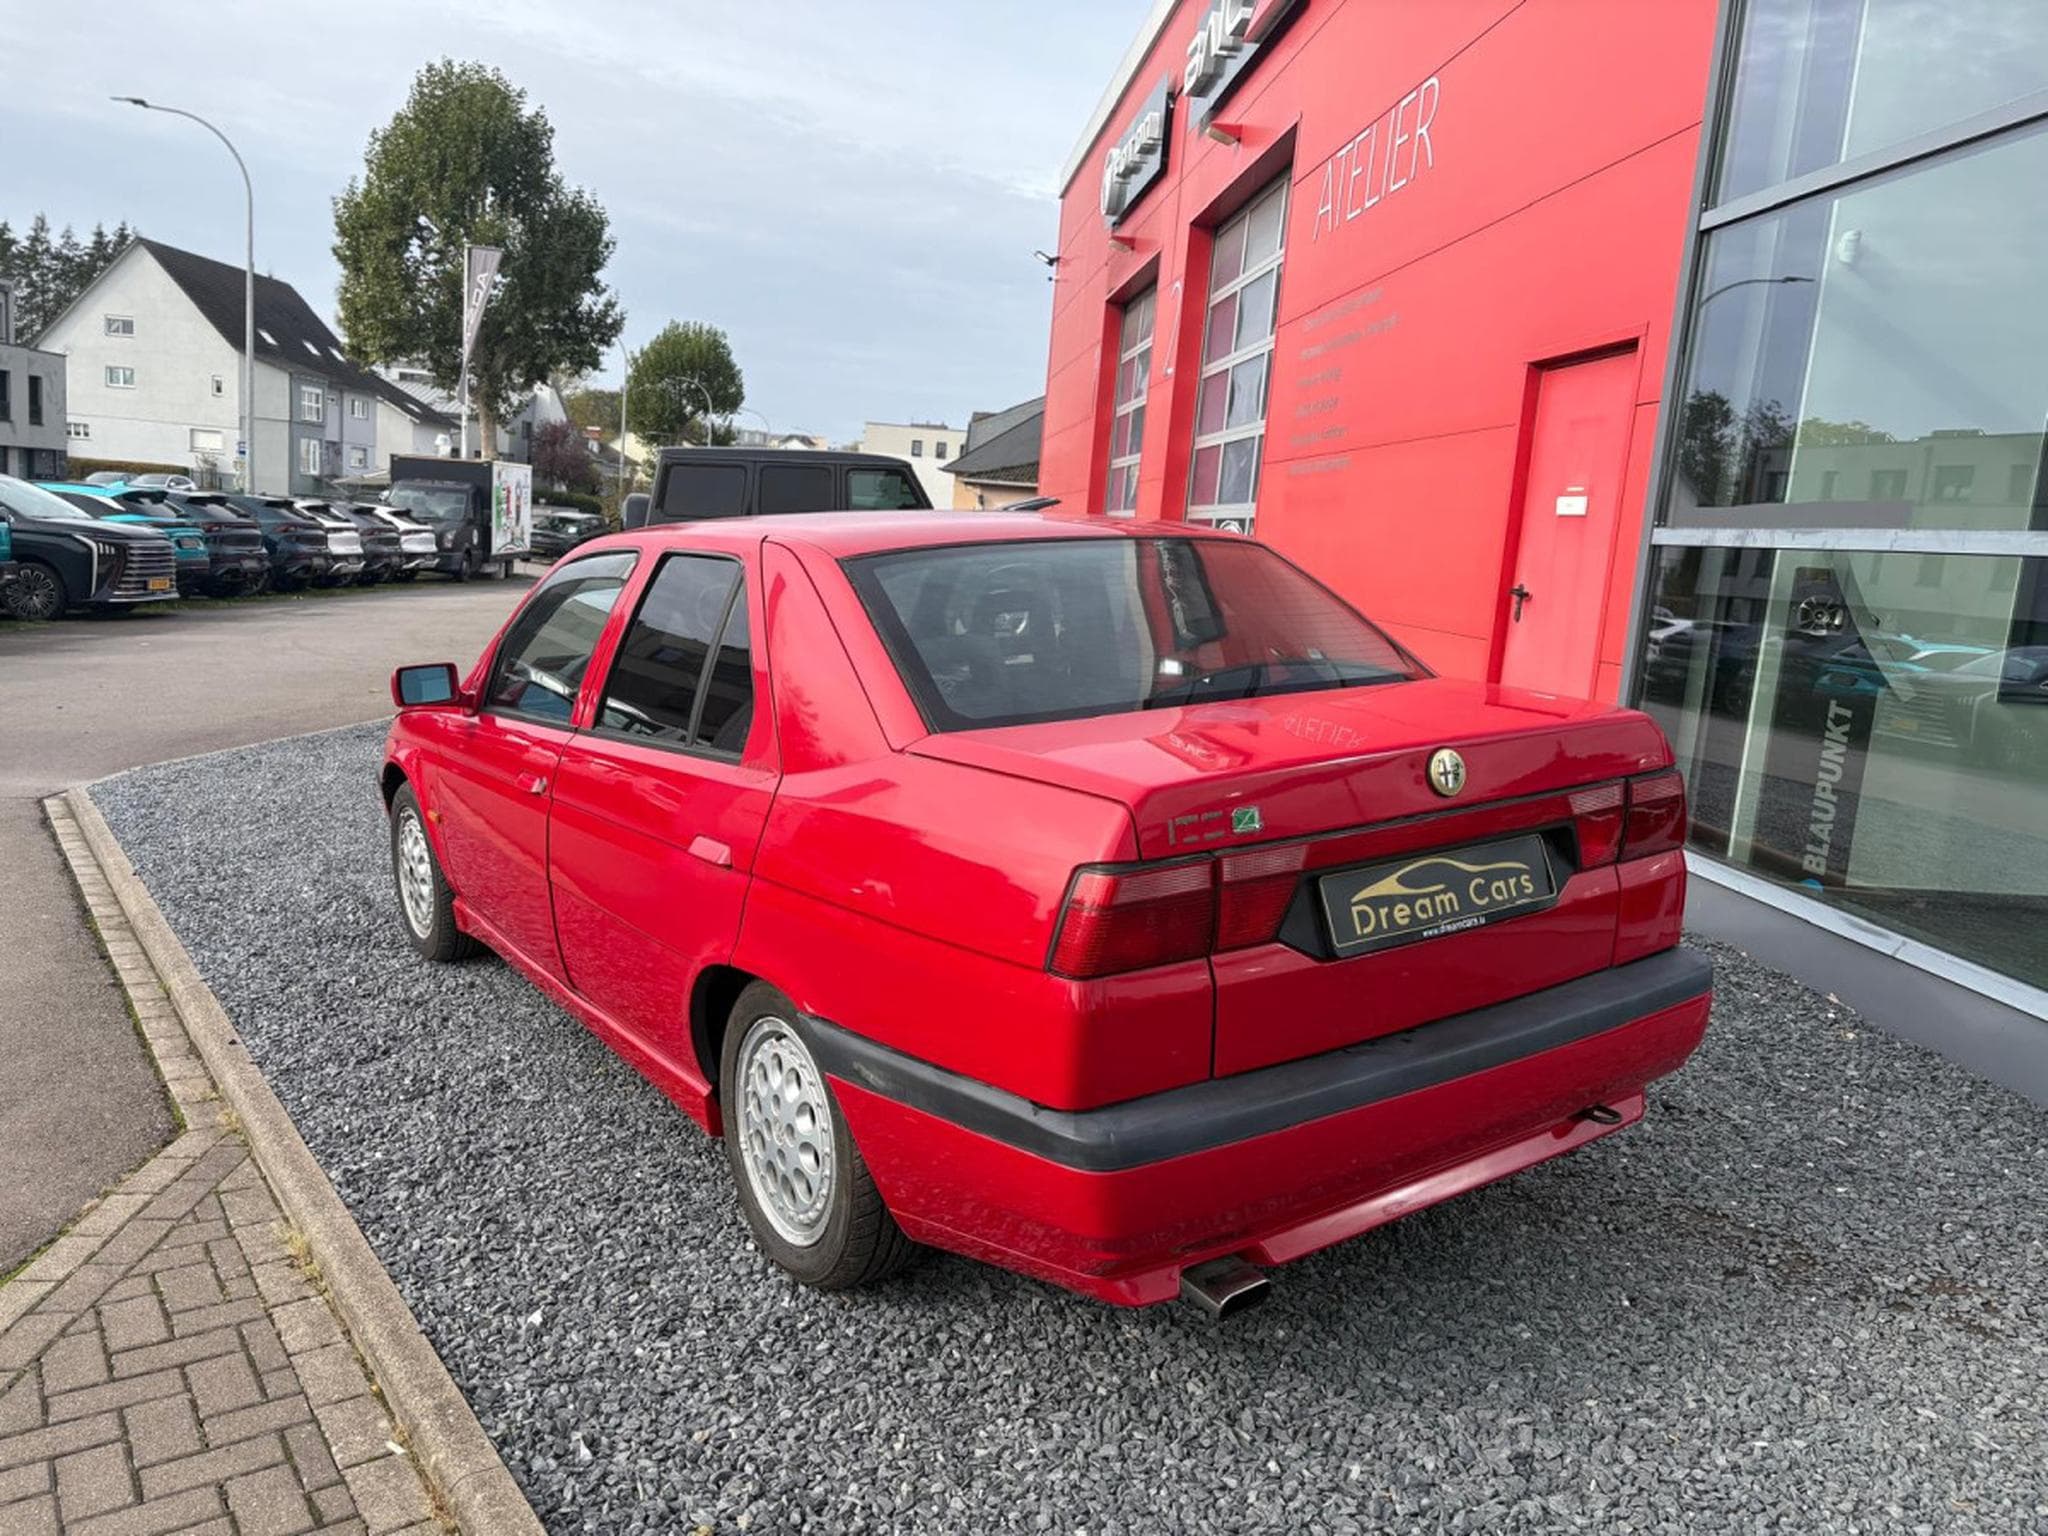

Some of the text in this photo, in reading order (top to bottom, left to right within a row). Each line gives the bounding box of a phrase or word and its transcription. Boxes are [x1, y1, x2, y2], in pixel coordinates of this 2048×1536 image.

[1313, 76, 1440, 243] ATELIER
[1802, 699, 1853, 877] BLAUPUNKT
[1351, 873, 1535, 936] Dream Cars
